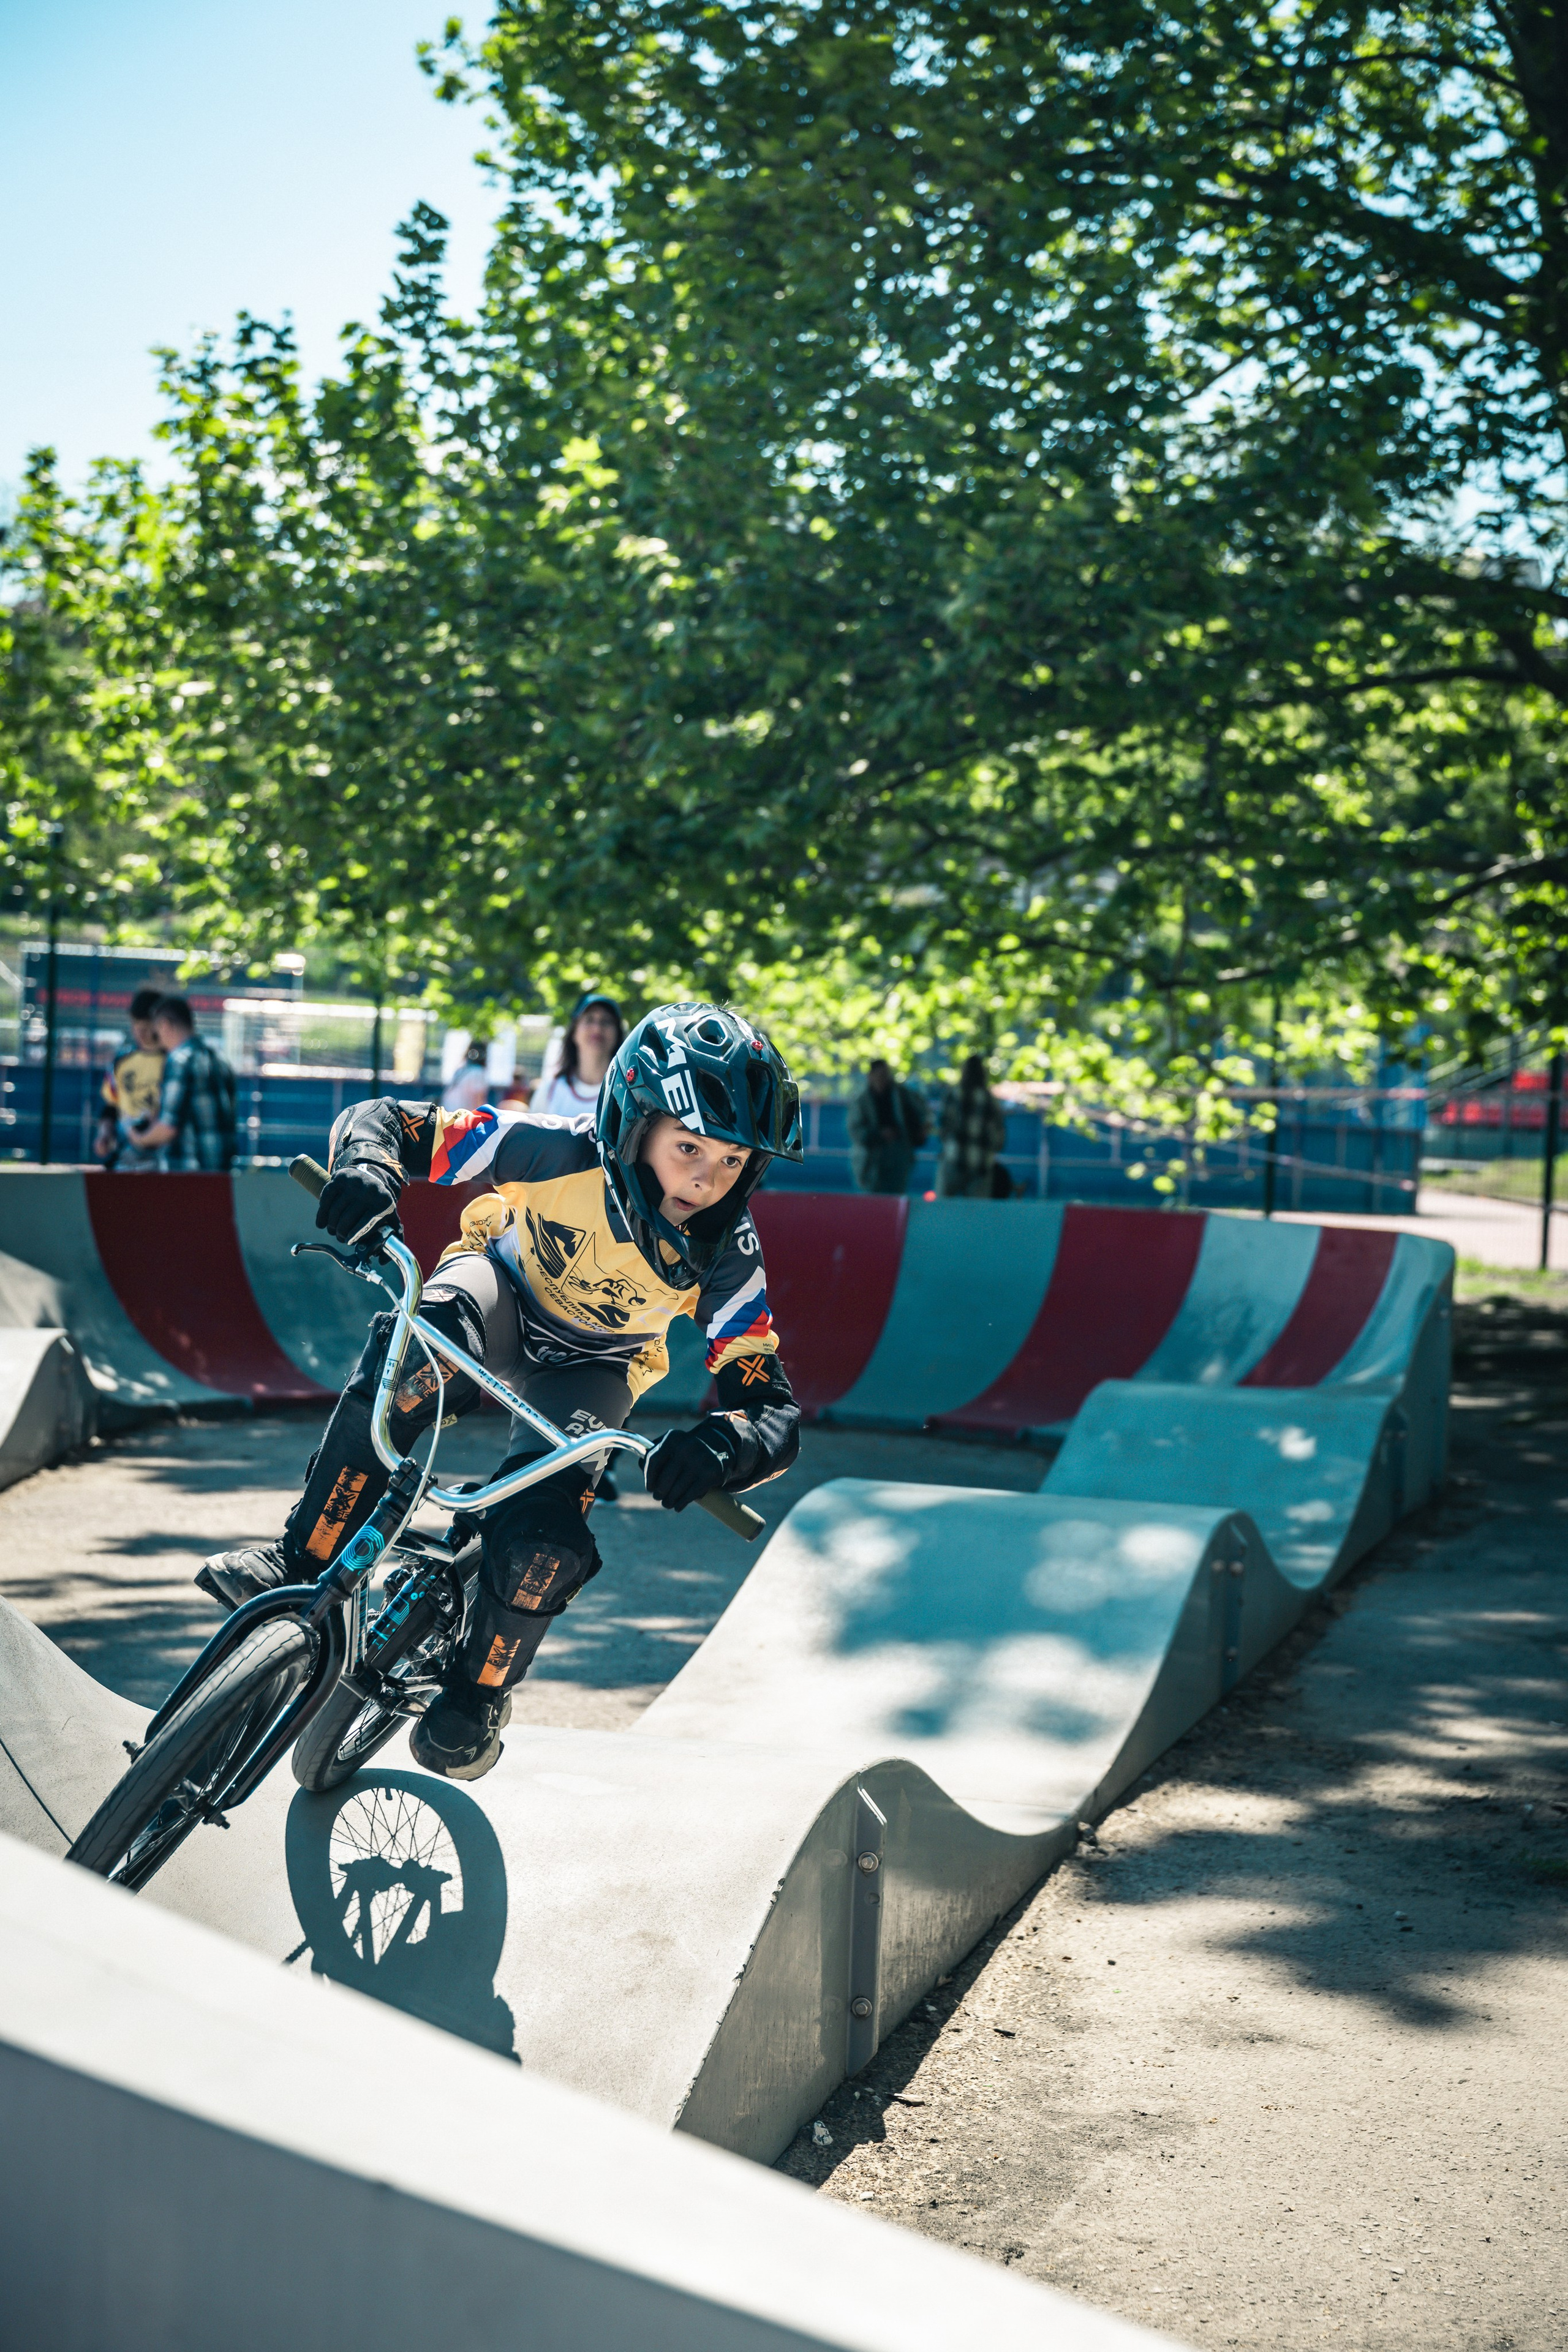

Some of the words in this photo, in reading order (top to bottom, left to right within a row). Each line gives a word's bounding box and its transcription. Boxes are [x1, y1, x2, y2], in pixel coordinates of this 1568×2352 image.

[654, 1017, 706, 1135] MET
[536, 1264, 591, 1321] РЕСПУБЛИКА
[545, 1287, 605, 1332] СЕВАСТОПО
[323, 1504, 350, 1520] FSE
